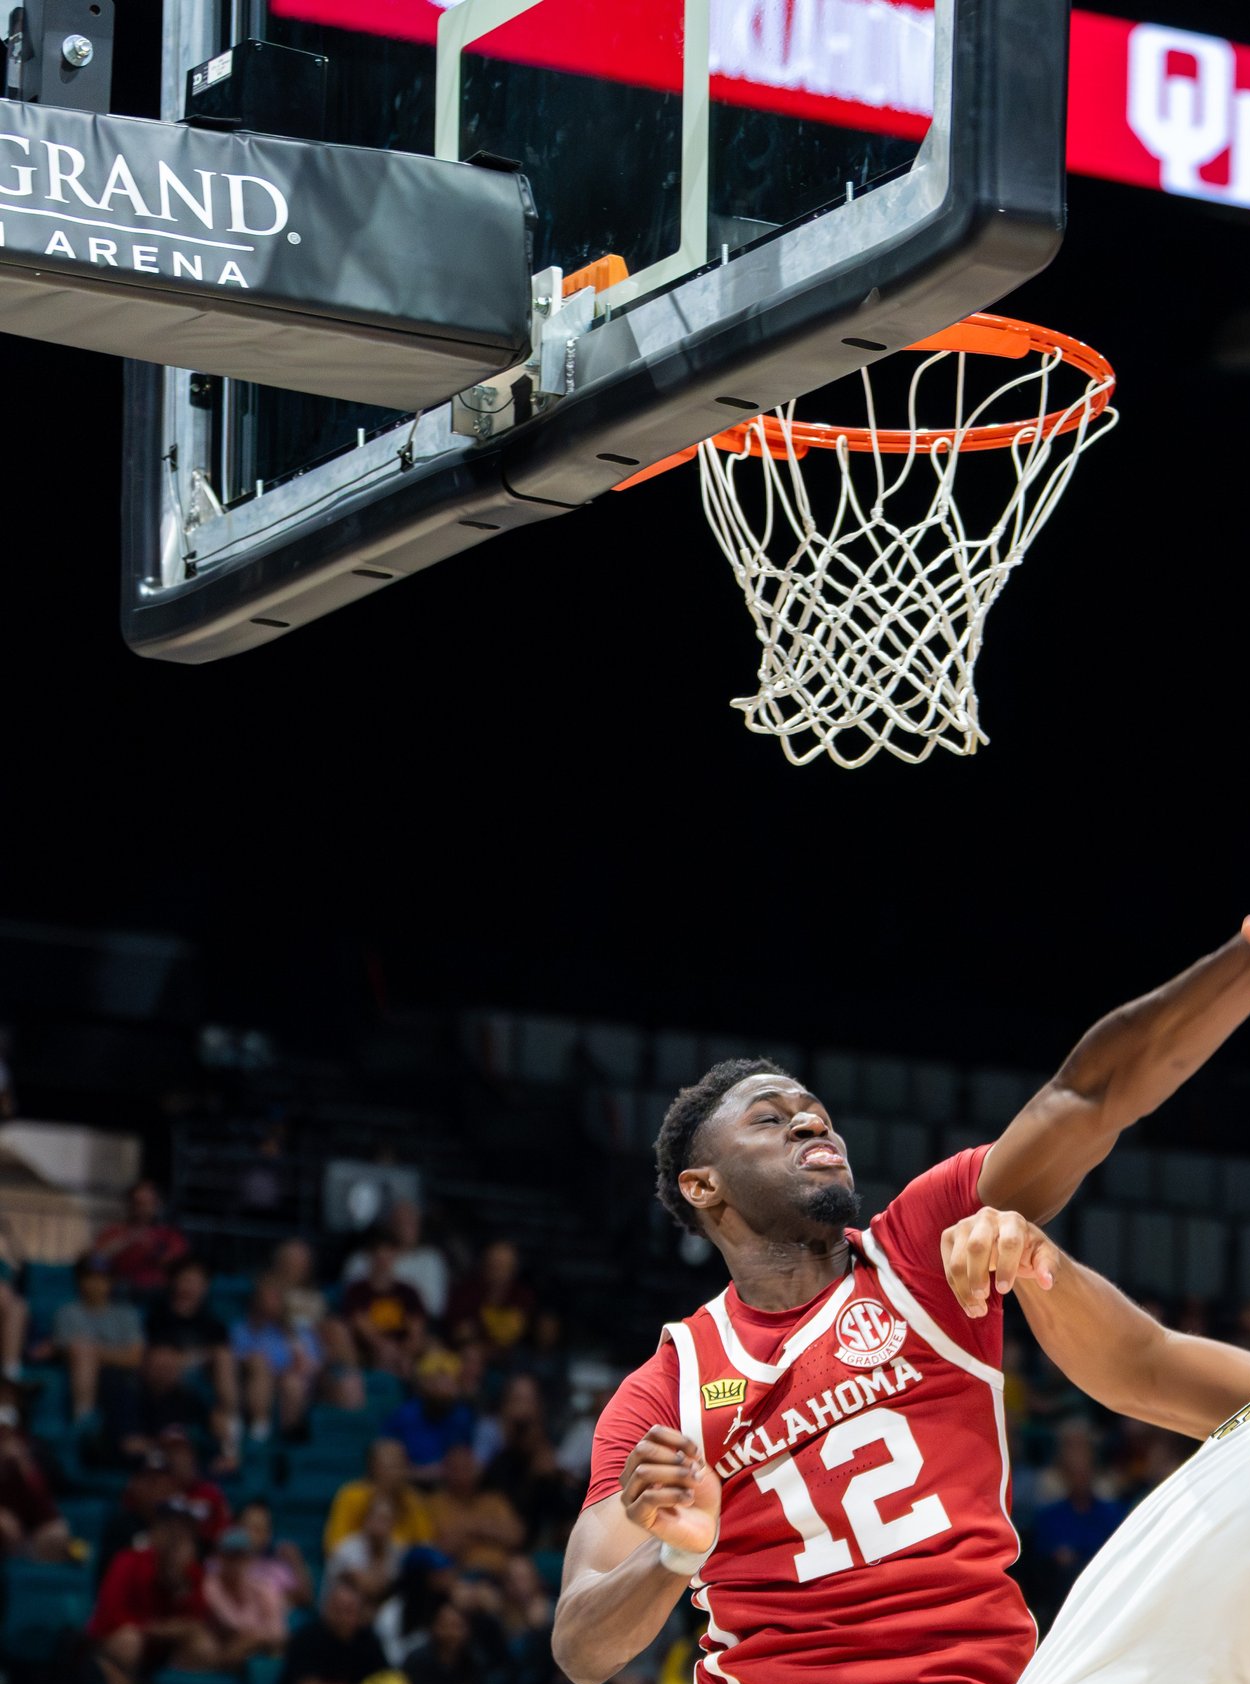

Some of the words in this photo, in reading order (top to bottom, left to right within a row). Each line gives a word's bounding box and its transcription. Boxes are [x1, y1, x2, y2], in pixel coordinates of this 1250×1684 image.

[0, 134, 288, 236] GRAND
[44, 230, 249, 288] ARENA
[841, 1302, 891, 1351] SEC
[846, 1333, 904, 1366] GRADUATE
[714, 1356, 923, 1479] OKLAHOMA
[754, 1407, 952, 1583] 12
